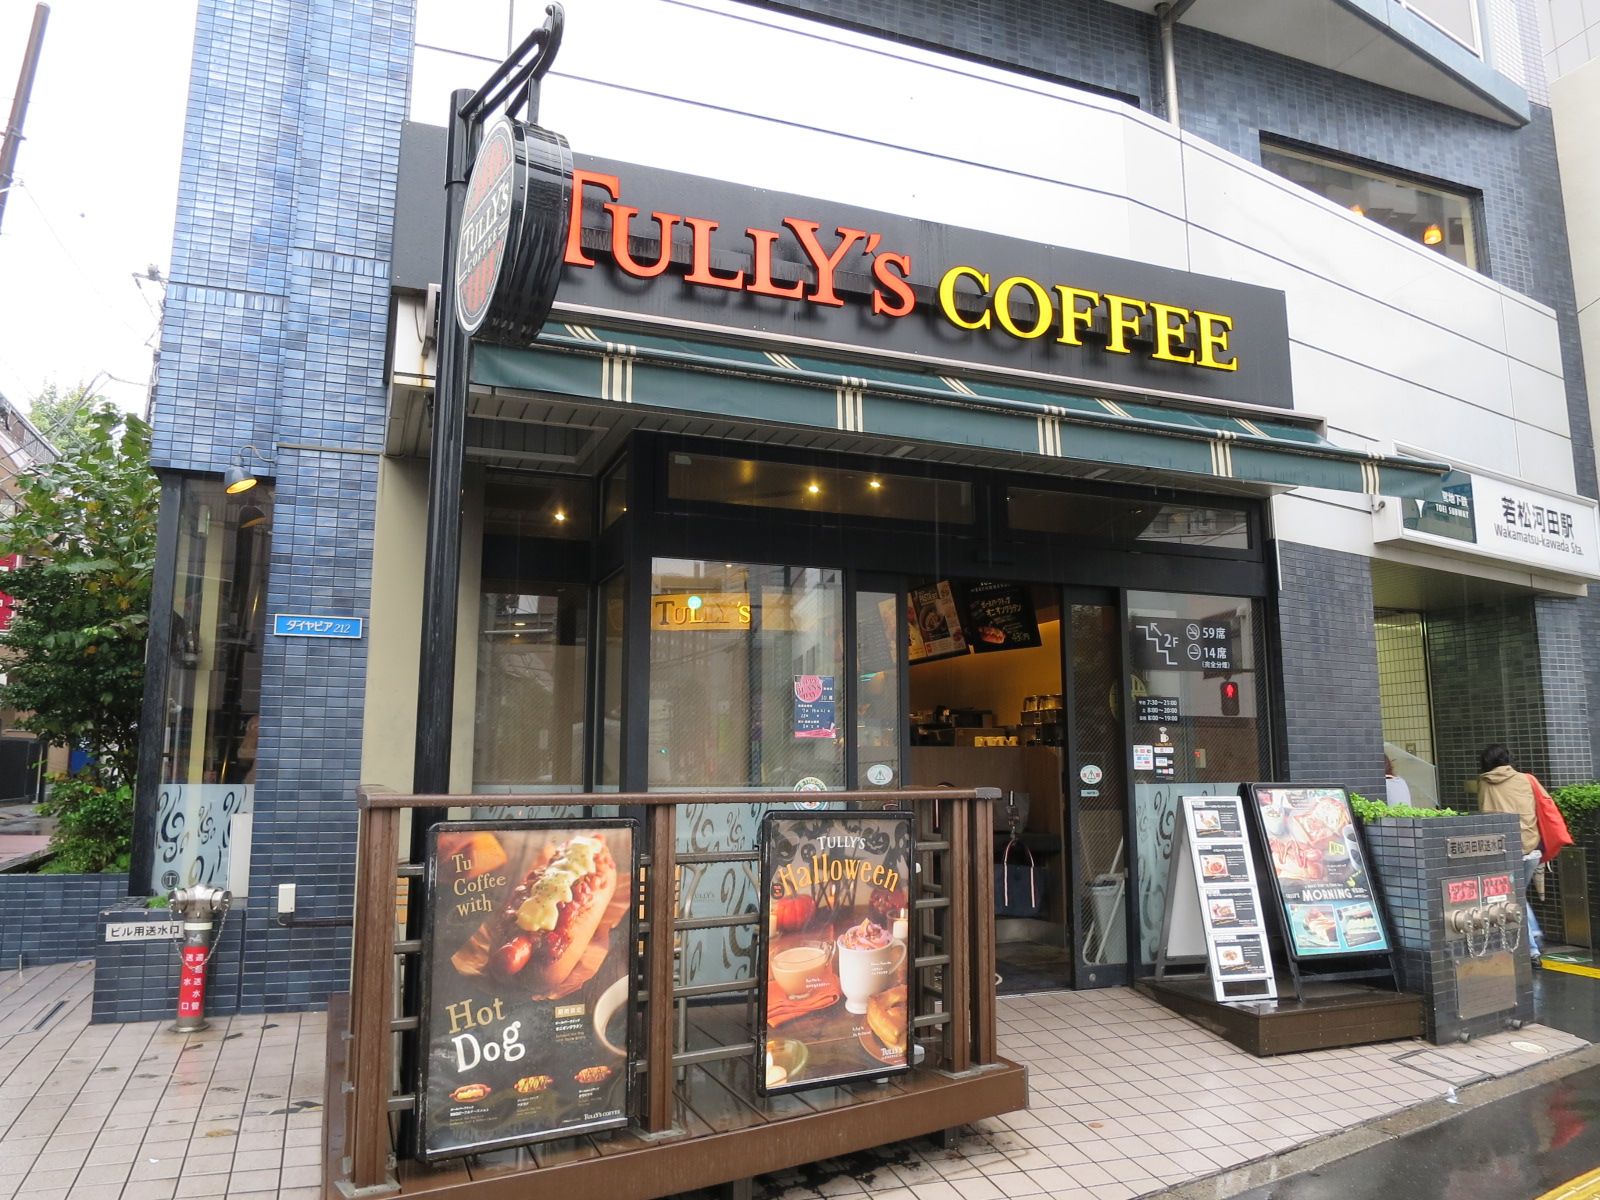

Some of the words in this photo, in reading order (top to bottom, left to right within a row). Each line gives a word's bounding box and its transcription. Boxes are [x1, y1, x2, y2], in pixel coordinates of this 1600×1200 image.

[463, 181, 510, 262] TULLY'S
[467, 226, 498, 273] COFFEE
[564, 169, 916, 318] TULLY'S
[938, 265, 1239, 373] COFFEE
[1501, 496, 1575, 540] 若松河田駅
[1494, 523, 1569, 553] Wakamatsu-kawada
[1164, 633, 1179, 648] 2F
[1202, 626, 1226, 640] 59席
[1203, 646, 1227, 660] 14席
[816, 835, 867, 850] TULLY'S
[452, 853, 472, 874] Tu
[778, 853, 900, 897] Halloween
[454, 873, 507, 897] Coffee
[1302, 888, 1353, 902] MORNING
[457, 894, 493, 918] with
[110, 923, 180, 938] ビル用送水口
[446, 998, 505, 1034] Hot
[452, 1021, 526, 1073] Dog
